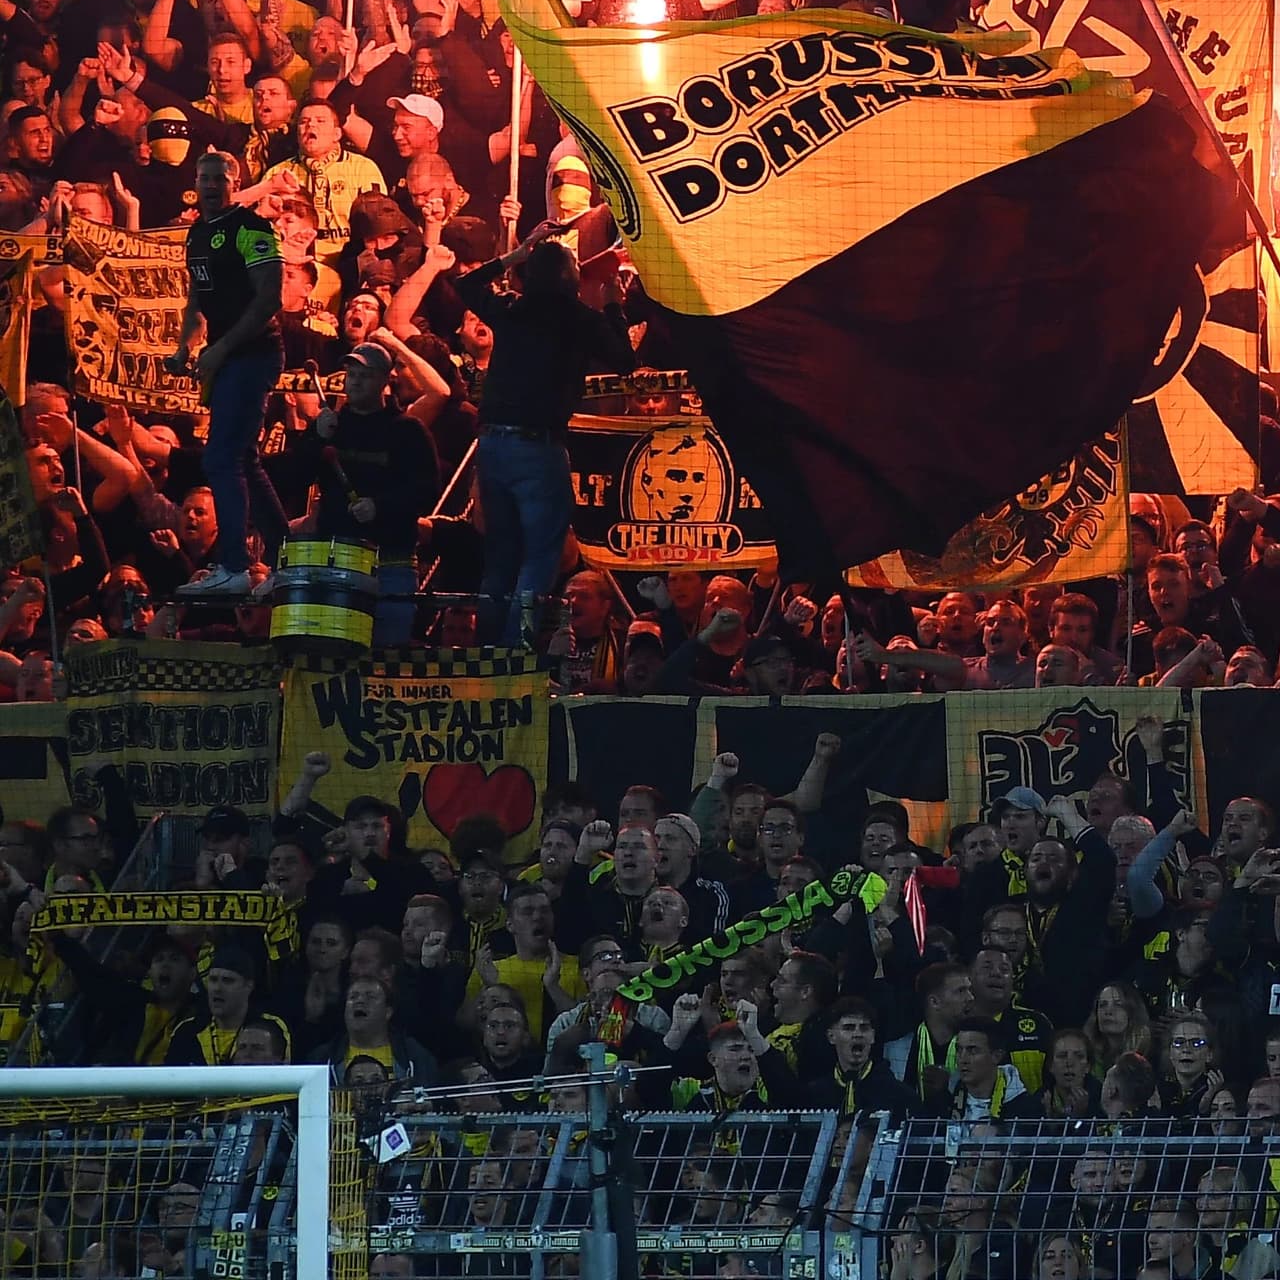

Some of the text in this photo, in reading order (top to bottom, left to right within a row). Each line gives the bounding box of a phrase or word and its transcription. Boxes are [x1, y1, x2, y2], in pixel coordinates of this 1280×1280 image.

[70, 219, 185, 262] STADIONVERB
[617, 524, 733, 554] THE UNITY
[311, 670, 533, 730] WESTFALEN
[363, 682, 453, 700] FÜR IMMER
[68, 703, 271, 755] SEKTION
[344, 729, 505, 770] STADION
[71, 760, 271, 808] SADION
[616, 879, 835, 1003] BORUSSIA
